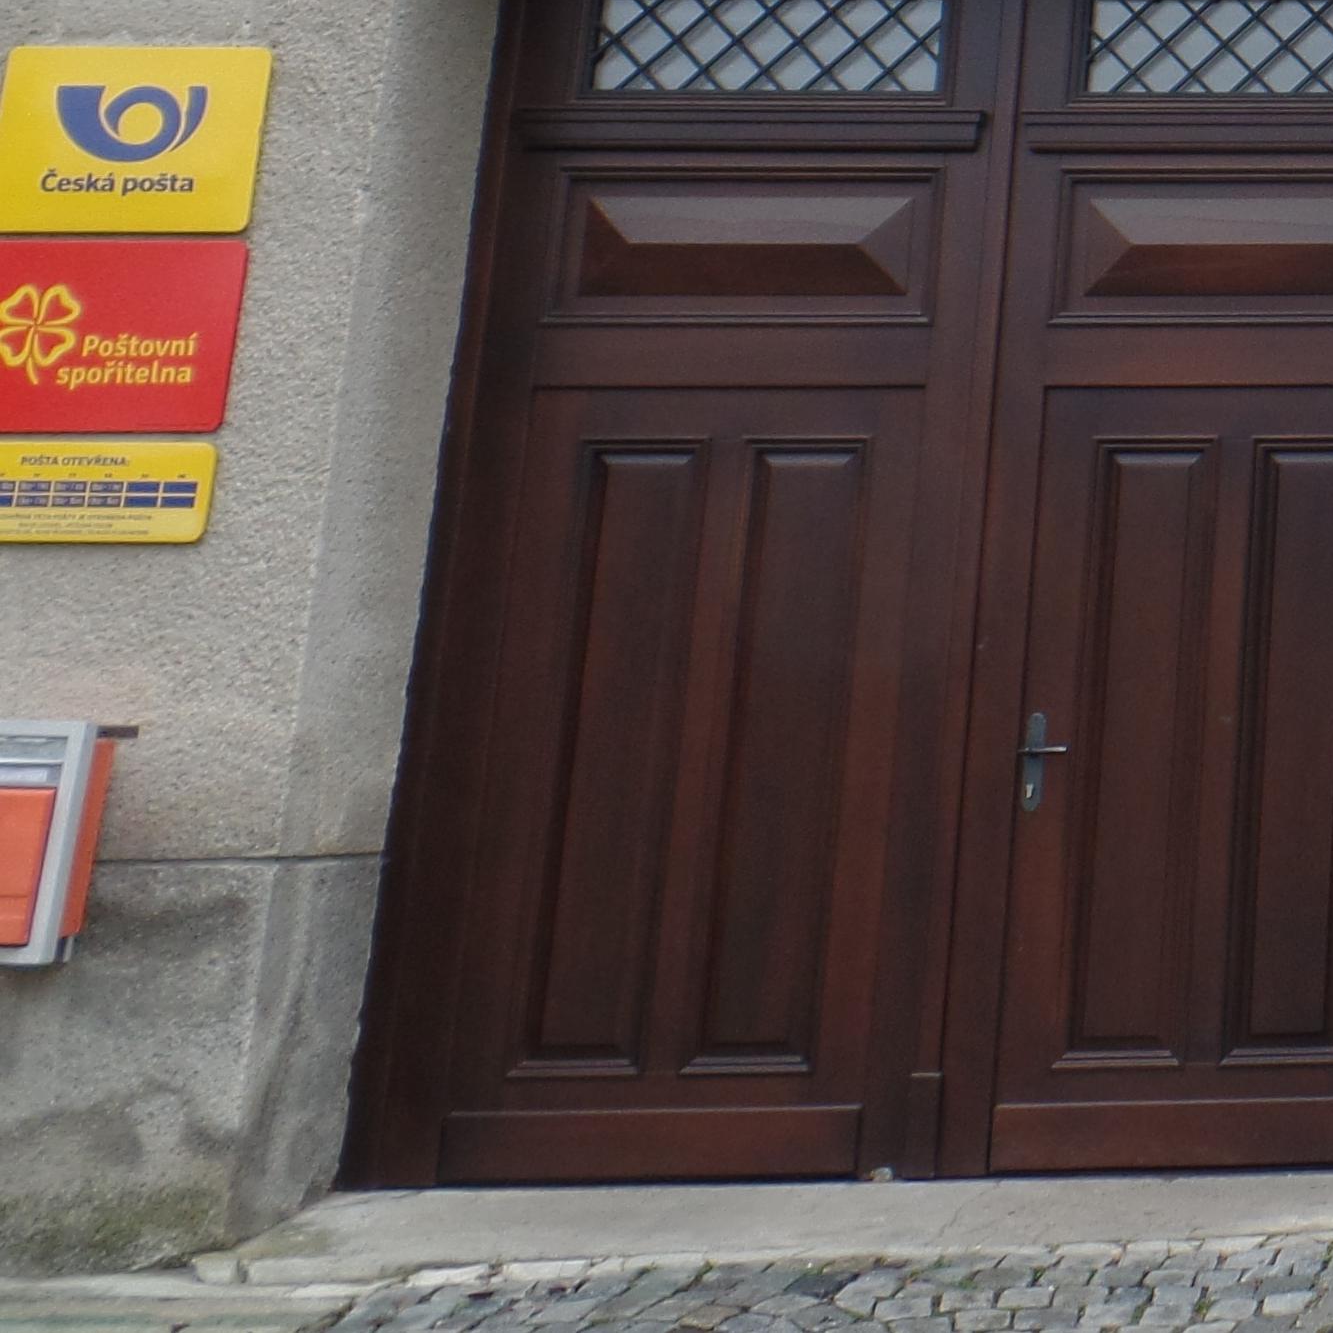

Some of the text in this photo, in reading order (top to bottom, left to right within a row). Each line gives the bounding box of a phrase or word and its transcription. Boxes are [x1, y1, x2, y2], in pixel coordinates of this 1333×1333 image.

[41, 168, 195, 196] Česká pošta
[82, 332, 198, 357] Poštovní
[56, 359, 193, 390] spořitelna
[20, 454, 59, 466] POŠTA
